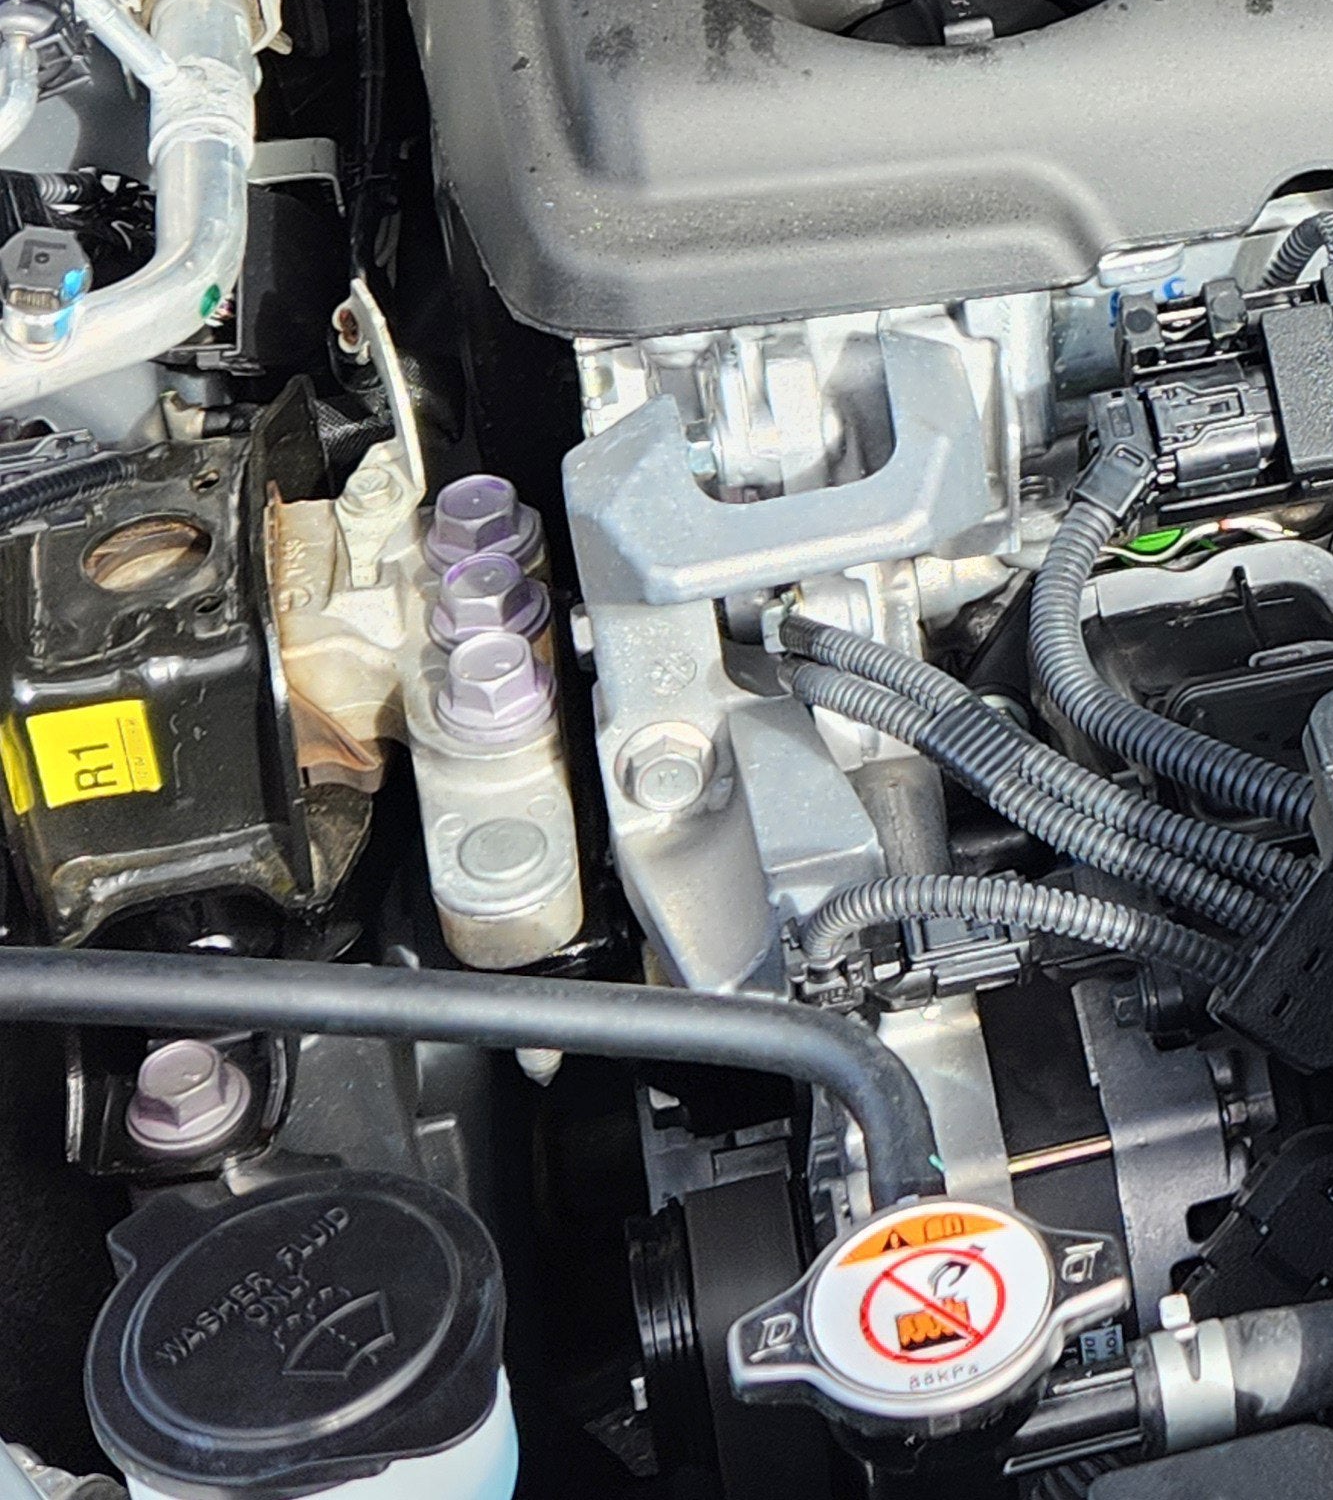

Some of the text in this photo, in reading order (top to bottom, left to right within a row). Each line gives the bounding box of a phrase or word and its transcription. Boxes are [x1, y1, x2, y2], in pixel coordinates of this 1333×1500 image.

[68, 742, 117, 792] R1
[156, 1206, 350, 1365] WASHER FLUID
[245, 1266, 310, 1326] ONLY
